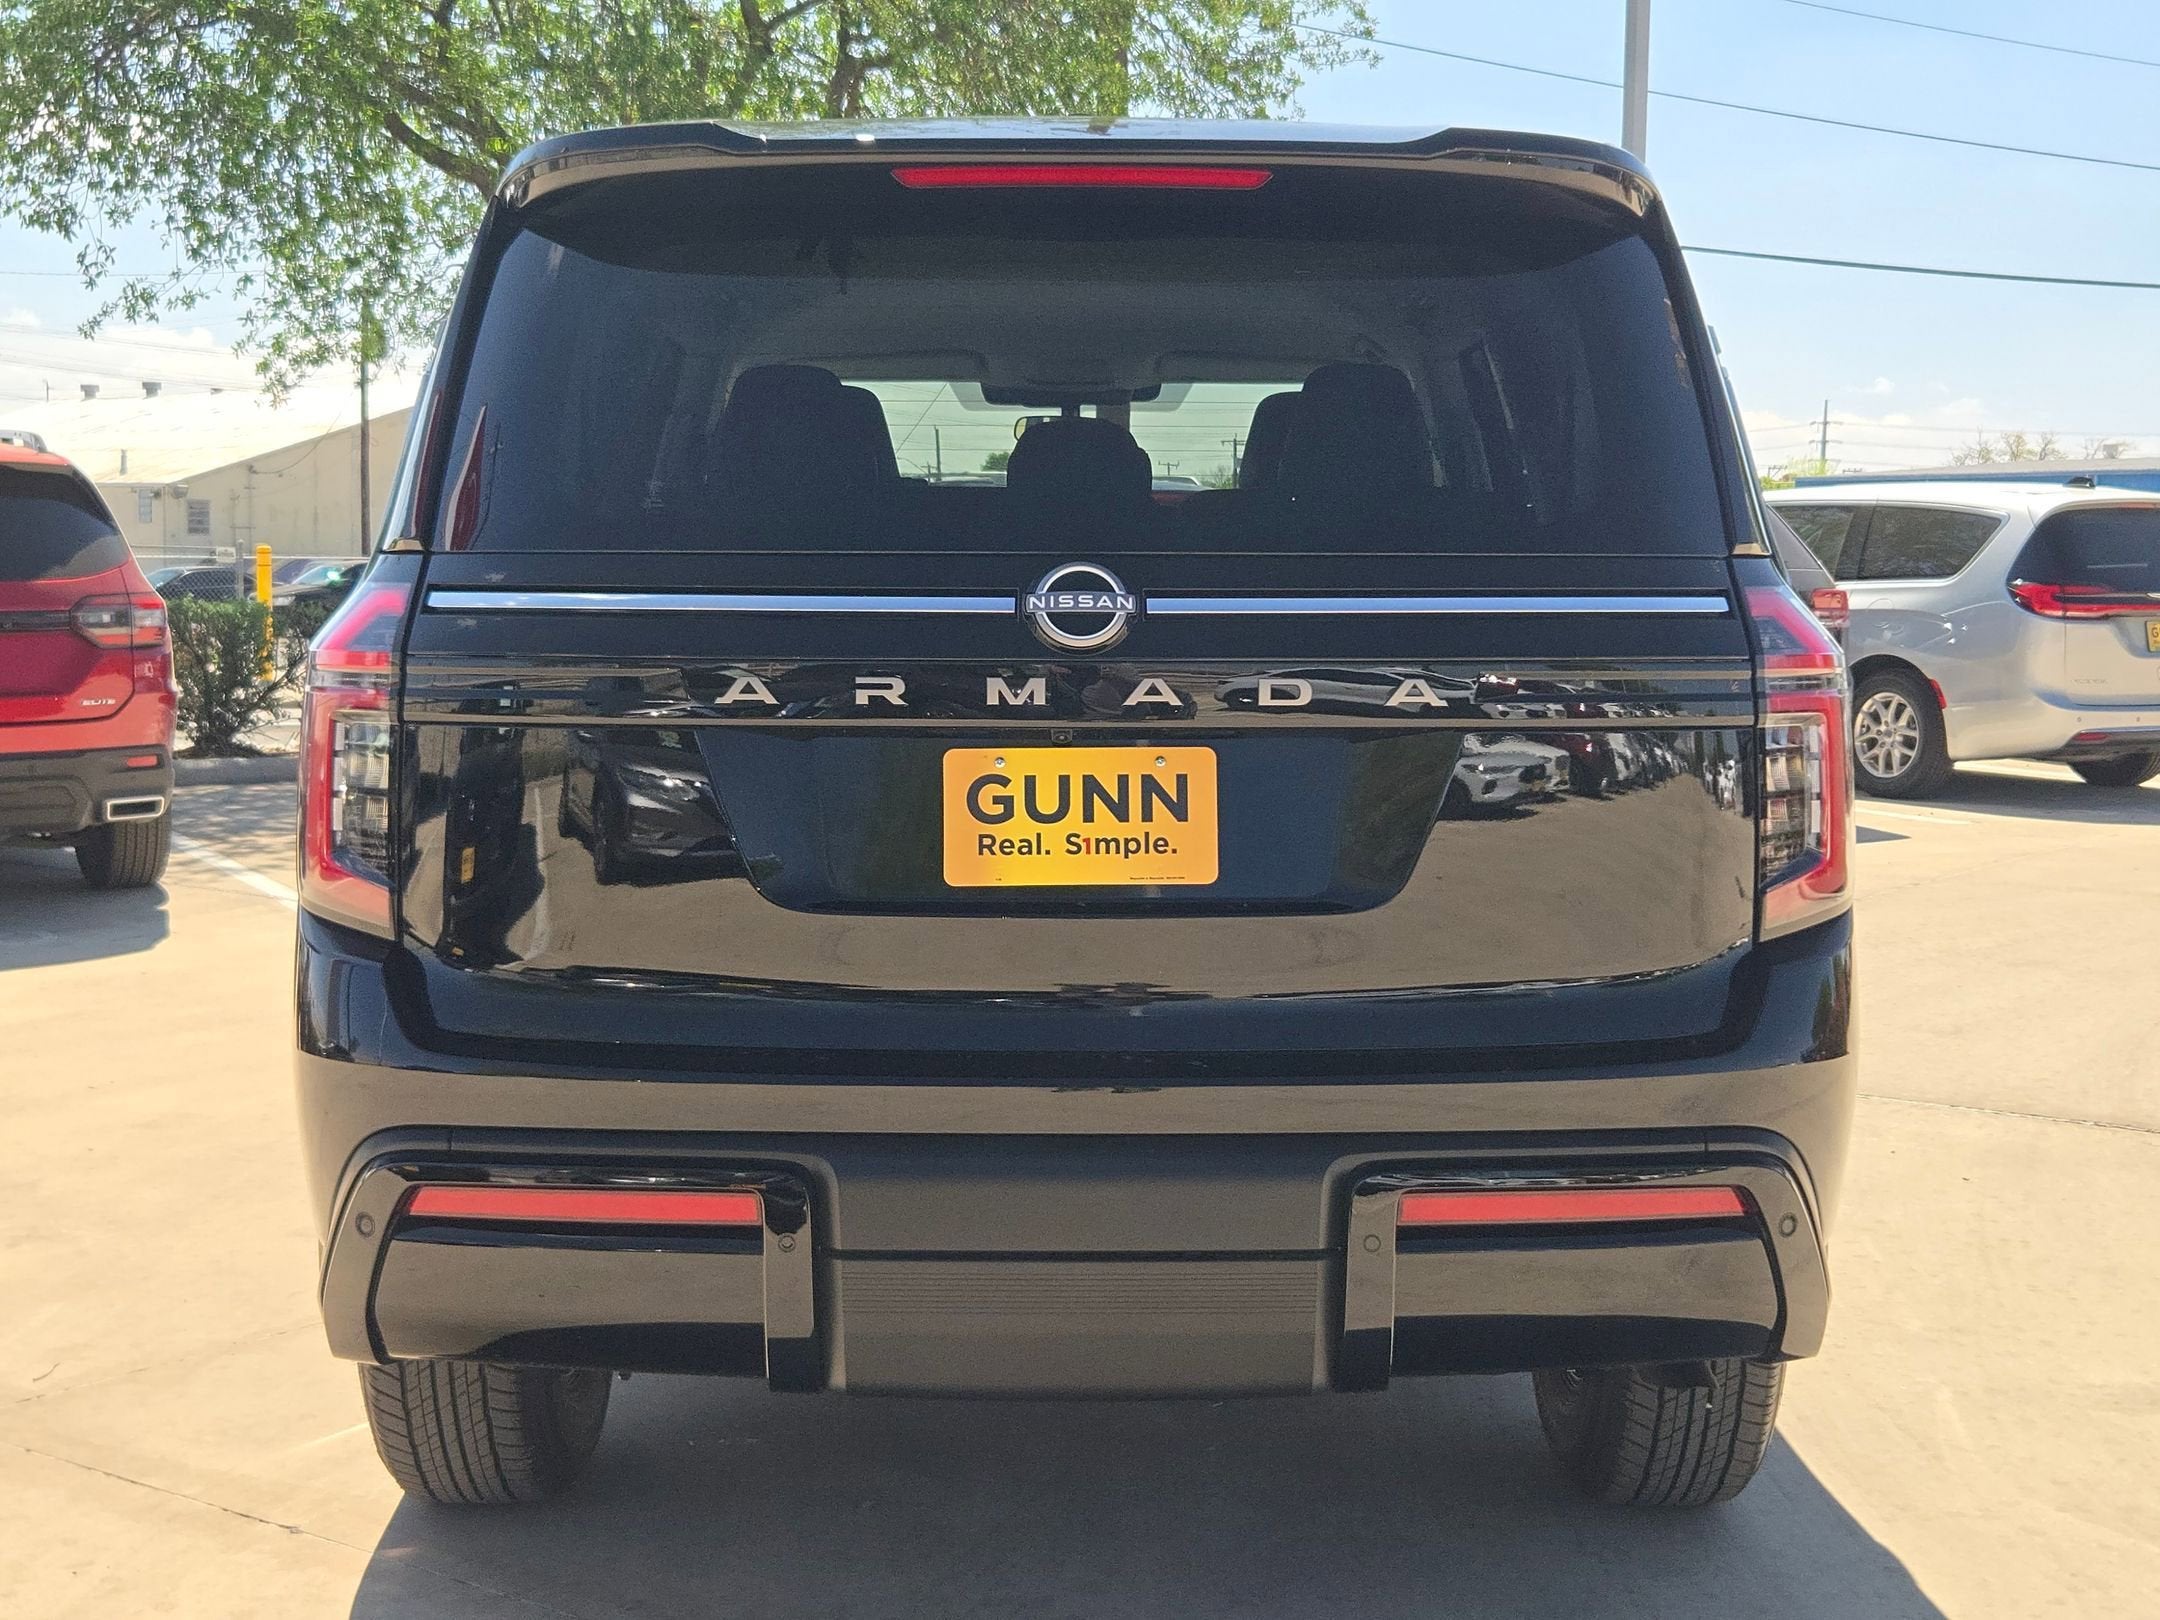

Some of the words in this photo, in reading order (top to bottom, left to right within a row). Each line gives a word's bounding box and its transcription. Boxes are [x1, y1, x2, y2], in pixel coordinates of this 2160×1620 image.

[1029, 594, 1133, 609] NISSAN
[714, 676, 1449, 708] ARMADA
[966, 773, 1189, 825] GUNN
[978, 832, 1051, 856] Real.
